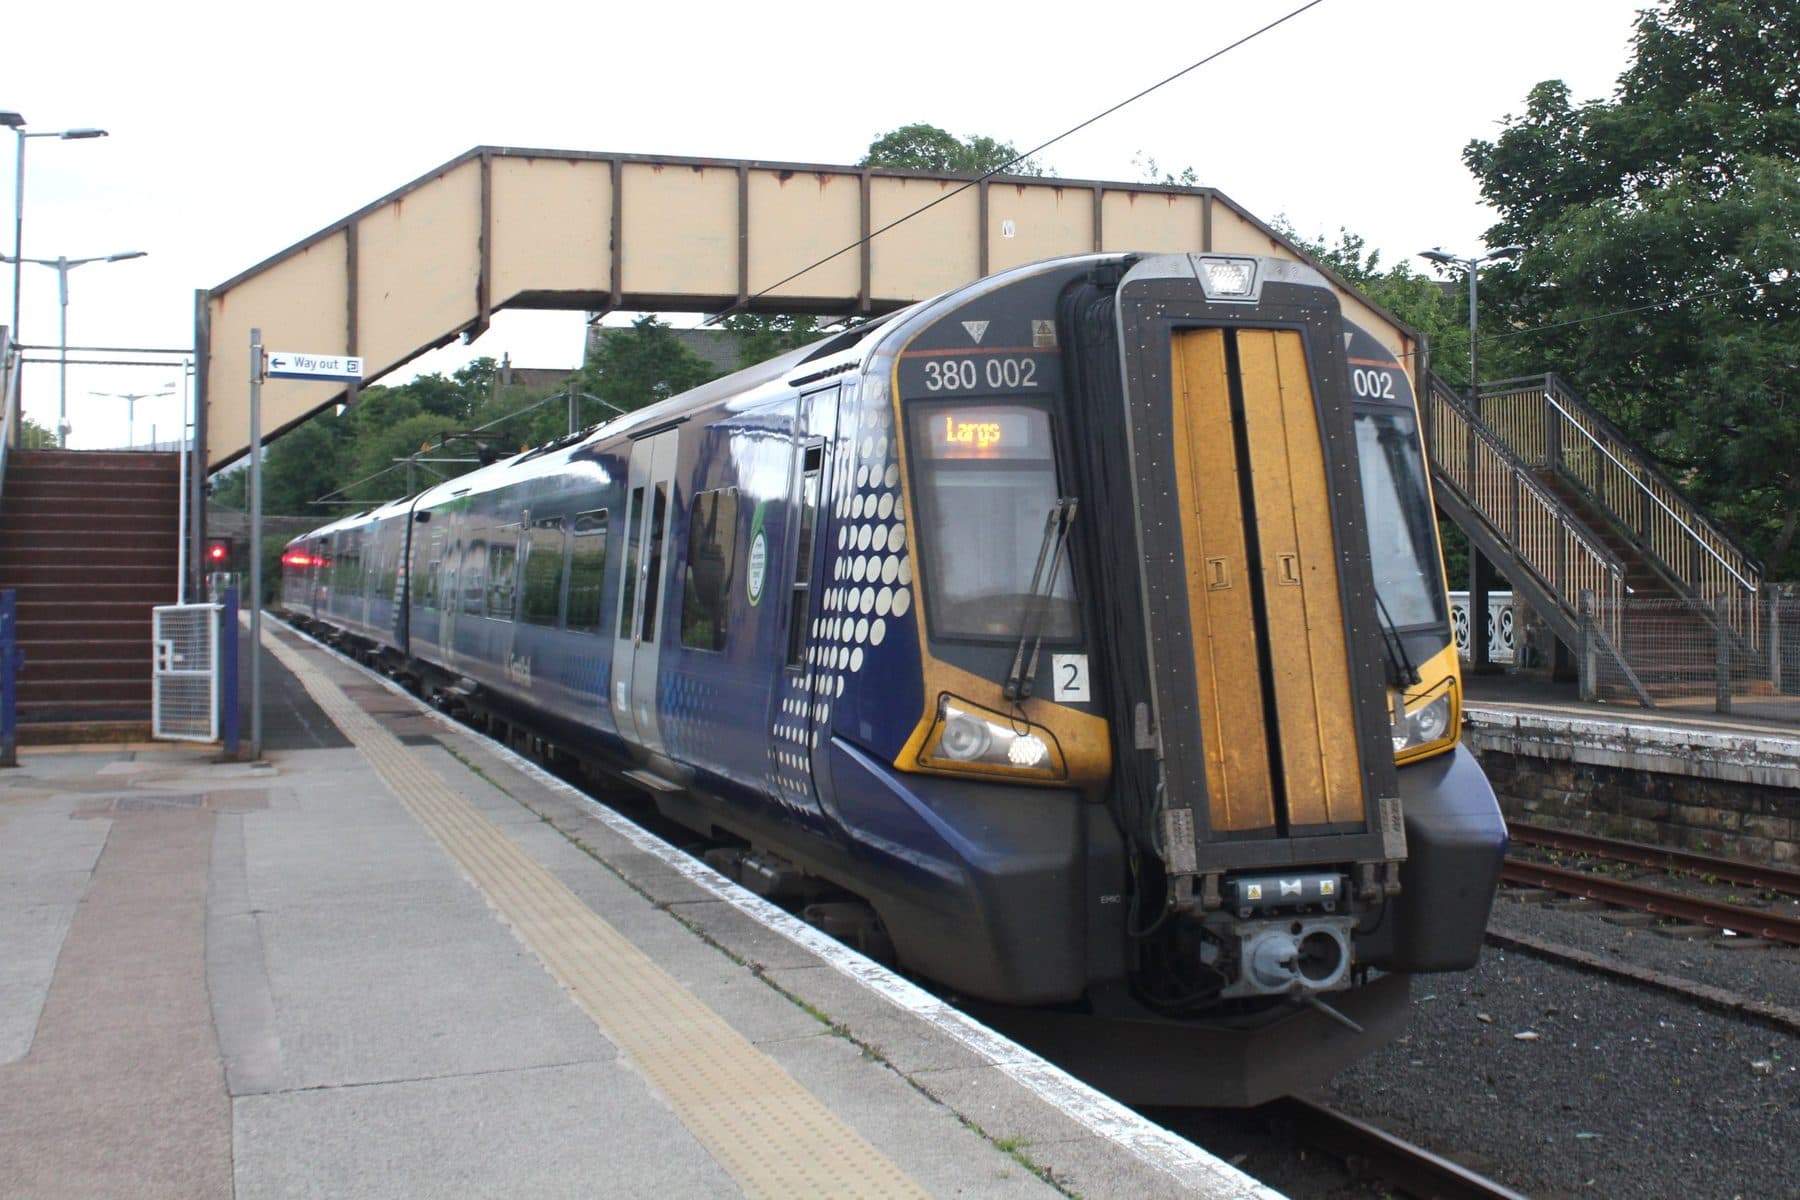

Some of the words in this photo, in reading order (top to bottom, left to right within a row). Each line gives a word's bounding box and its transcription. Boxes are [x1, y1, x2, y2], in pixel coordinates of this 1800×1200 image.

[294, 356, 317, 371] Way
[320, 359, 340, 370] out
[924, 359, 977, 391] 380
[985, 358, 1038, 388] 002
[1353, 368, 1395, 399] 002
[946, 416, 1001, 448] Largs
[1062, 663, 1081, 691] 2
